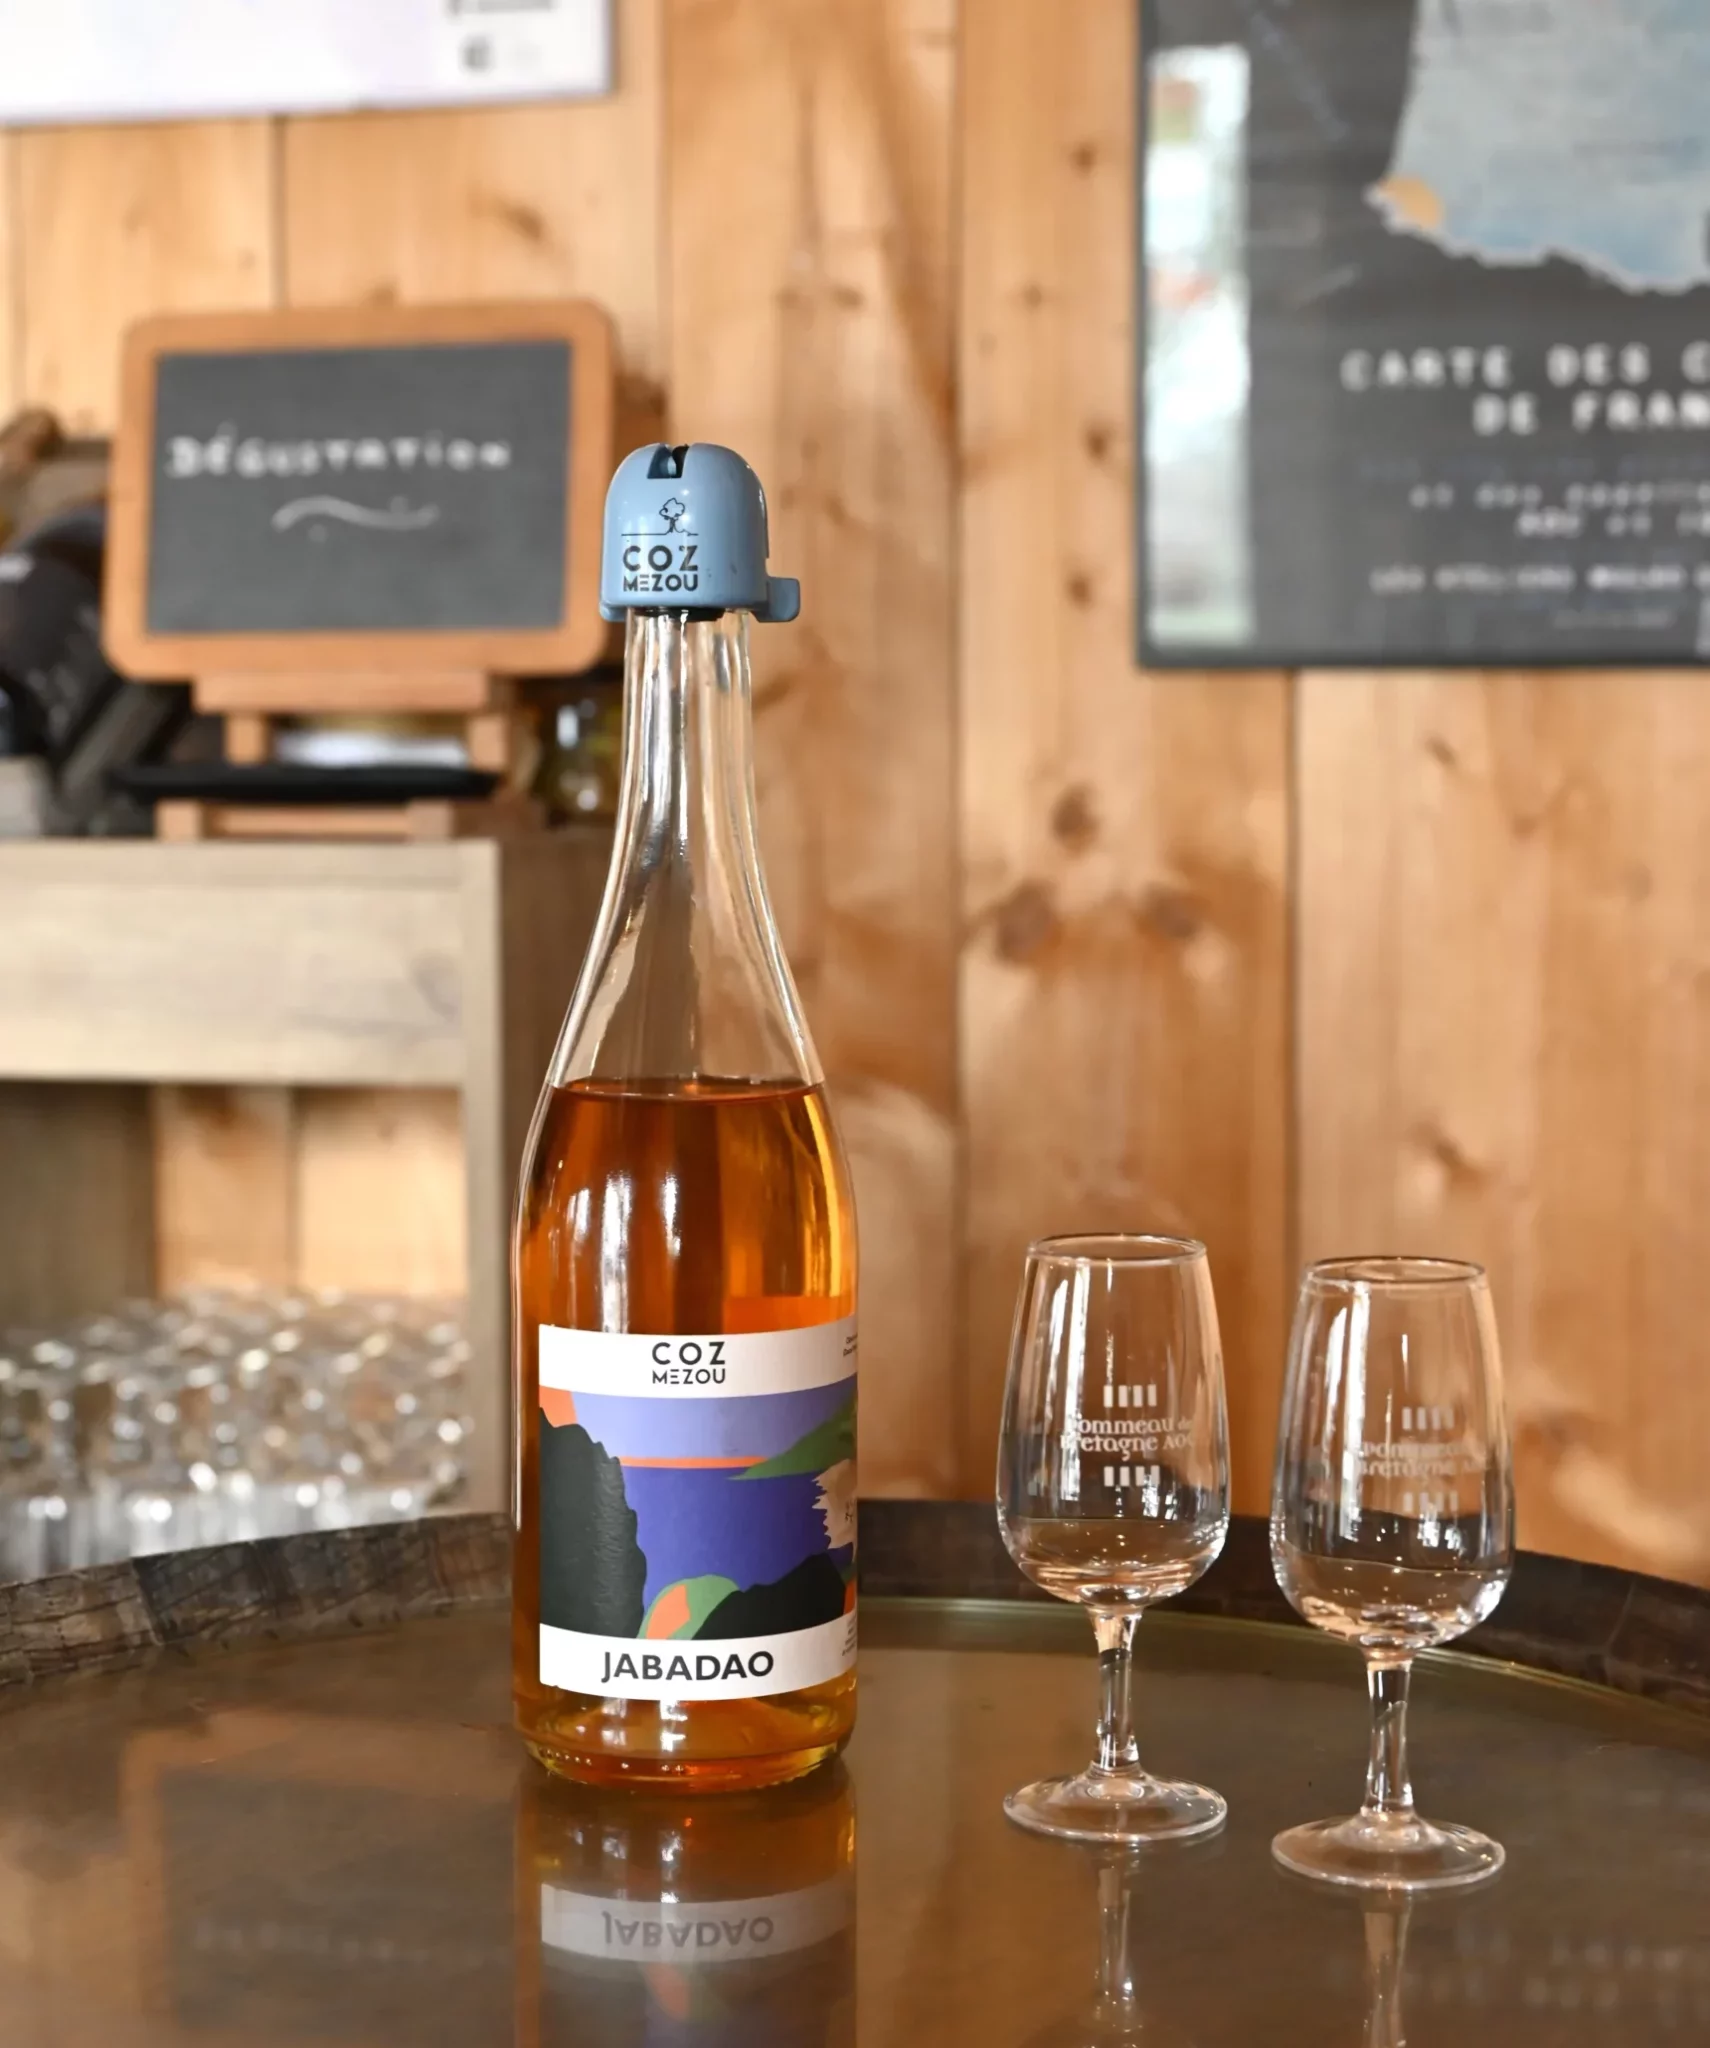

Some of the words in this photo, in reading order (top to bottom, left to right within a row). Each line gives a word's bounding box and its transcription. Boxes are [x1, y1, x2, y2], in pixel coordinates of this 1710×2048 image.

[1340, 348, 1509, 391] CARTE
[1473, 392, 1536, 435] DE
[623, 545, 698, 571] COZ
[623, 574, 698, 592] MEZOU
[651, 1341, 726, 1366] COZ
[652, 1369, 726, 1385] MEZOU
[1068, 1417, 1174, 1434] ommeau
[601, 1651, 774, 1684] JABADAO
